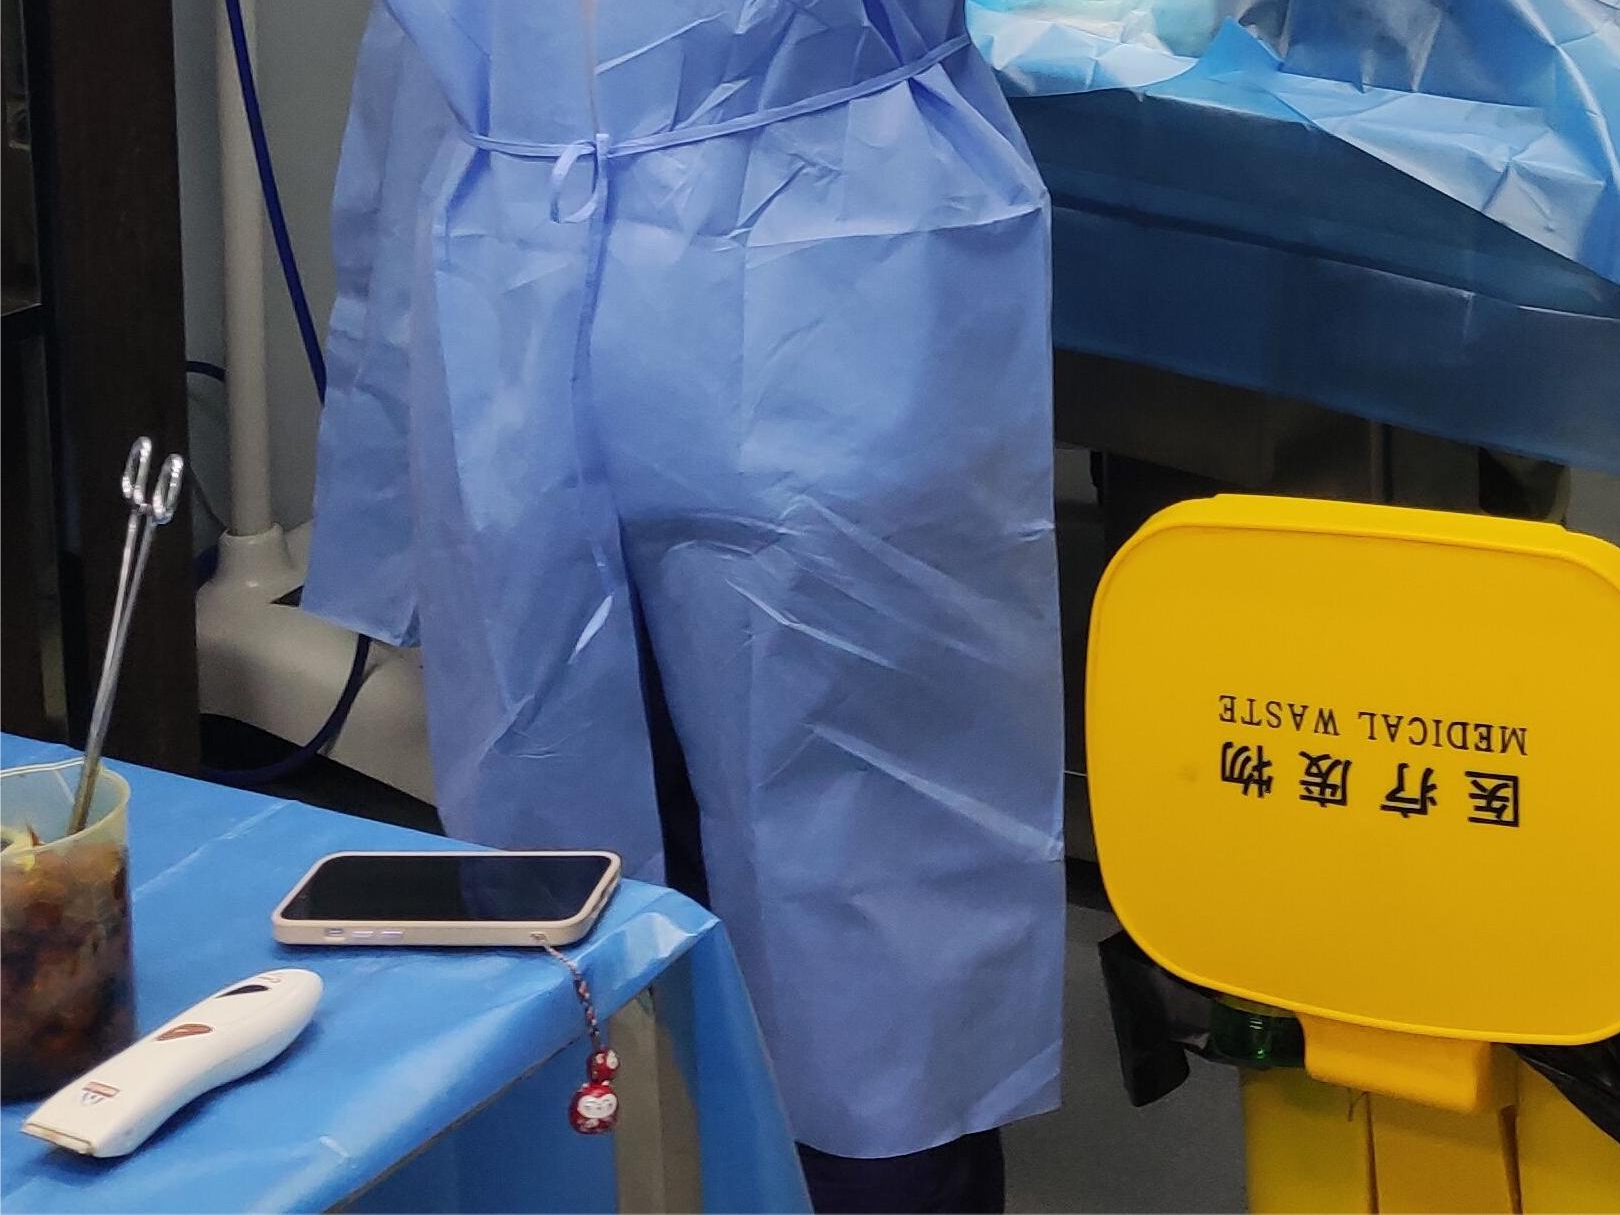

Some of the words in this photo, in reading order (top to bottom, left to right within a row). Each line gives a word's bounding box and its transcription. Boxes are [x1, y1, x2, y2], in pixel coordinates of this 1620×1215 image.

[1218, 694, 1340, 736] WASTE
[1358, 711, 1528, 756] MEDICAL
[1220, 741, 1520, 827] 医疗废物
